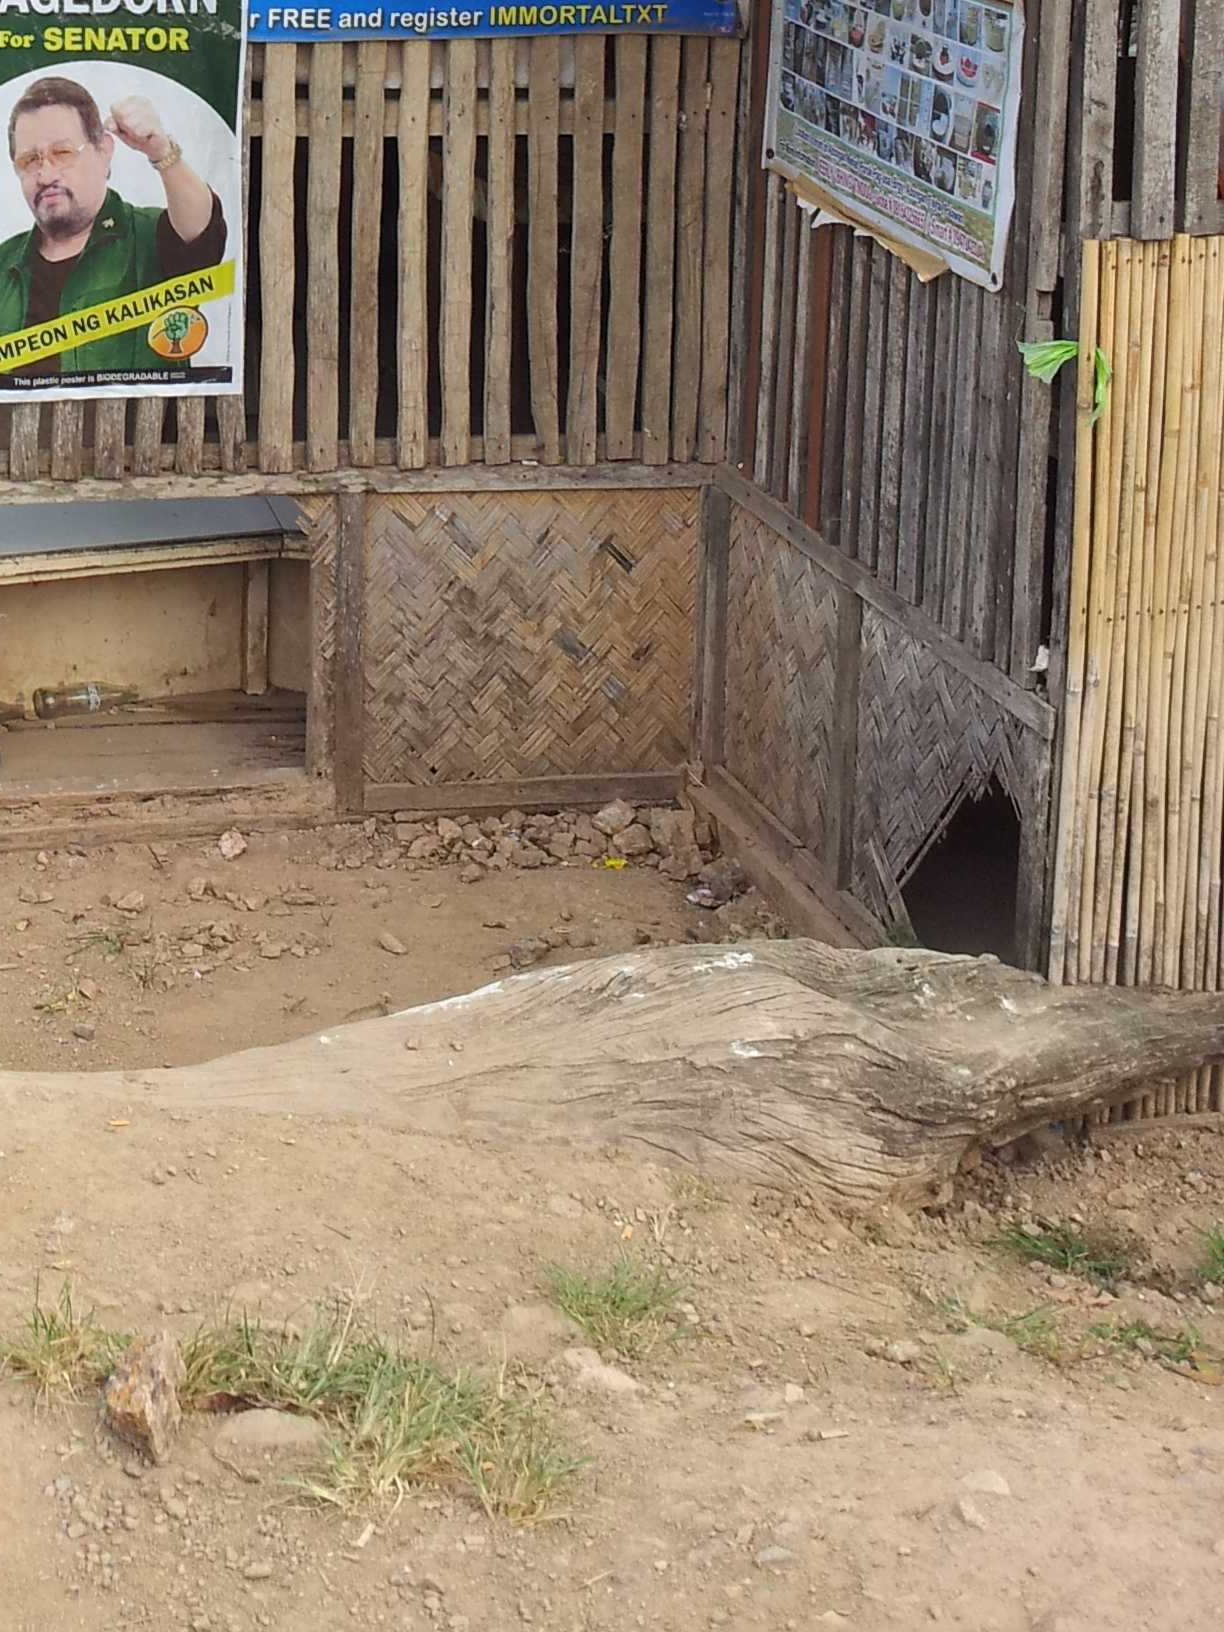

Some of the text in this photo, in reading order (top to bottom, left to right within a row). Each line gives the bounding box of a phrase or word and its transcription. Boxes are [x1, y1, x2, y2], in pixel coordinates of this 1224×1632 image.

[267, 7, 332, 29] FREE
[338, 8, 382, 29] and
[389, 6, 485, 35] register
[488, 3, 668, 26] IMMORTALTXT
[43, 27, 190, 51] SENATOR
[72, 314, 101, 336] NG
[104, 274, 214, 325] KALIKASAN
[14, 377, 31, 387] This
[33, 376, 59, 387] plastic
[61, 374, 86, 385] poster
[88, 374, 95, 383] is
[96, 371, 169, 382] BIODEGRADABLE
